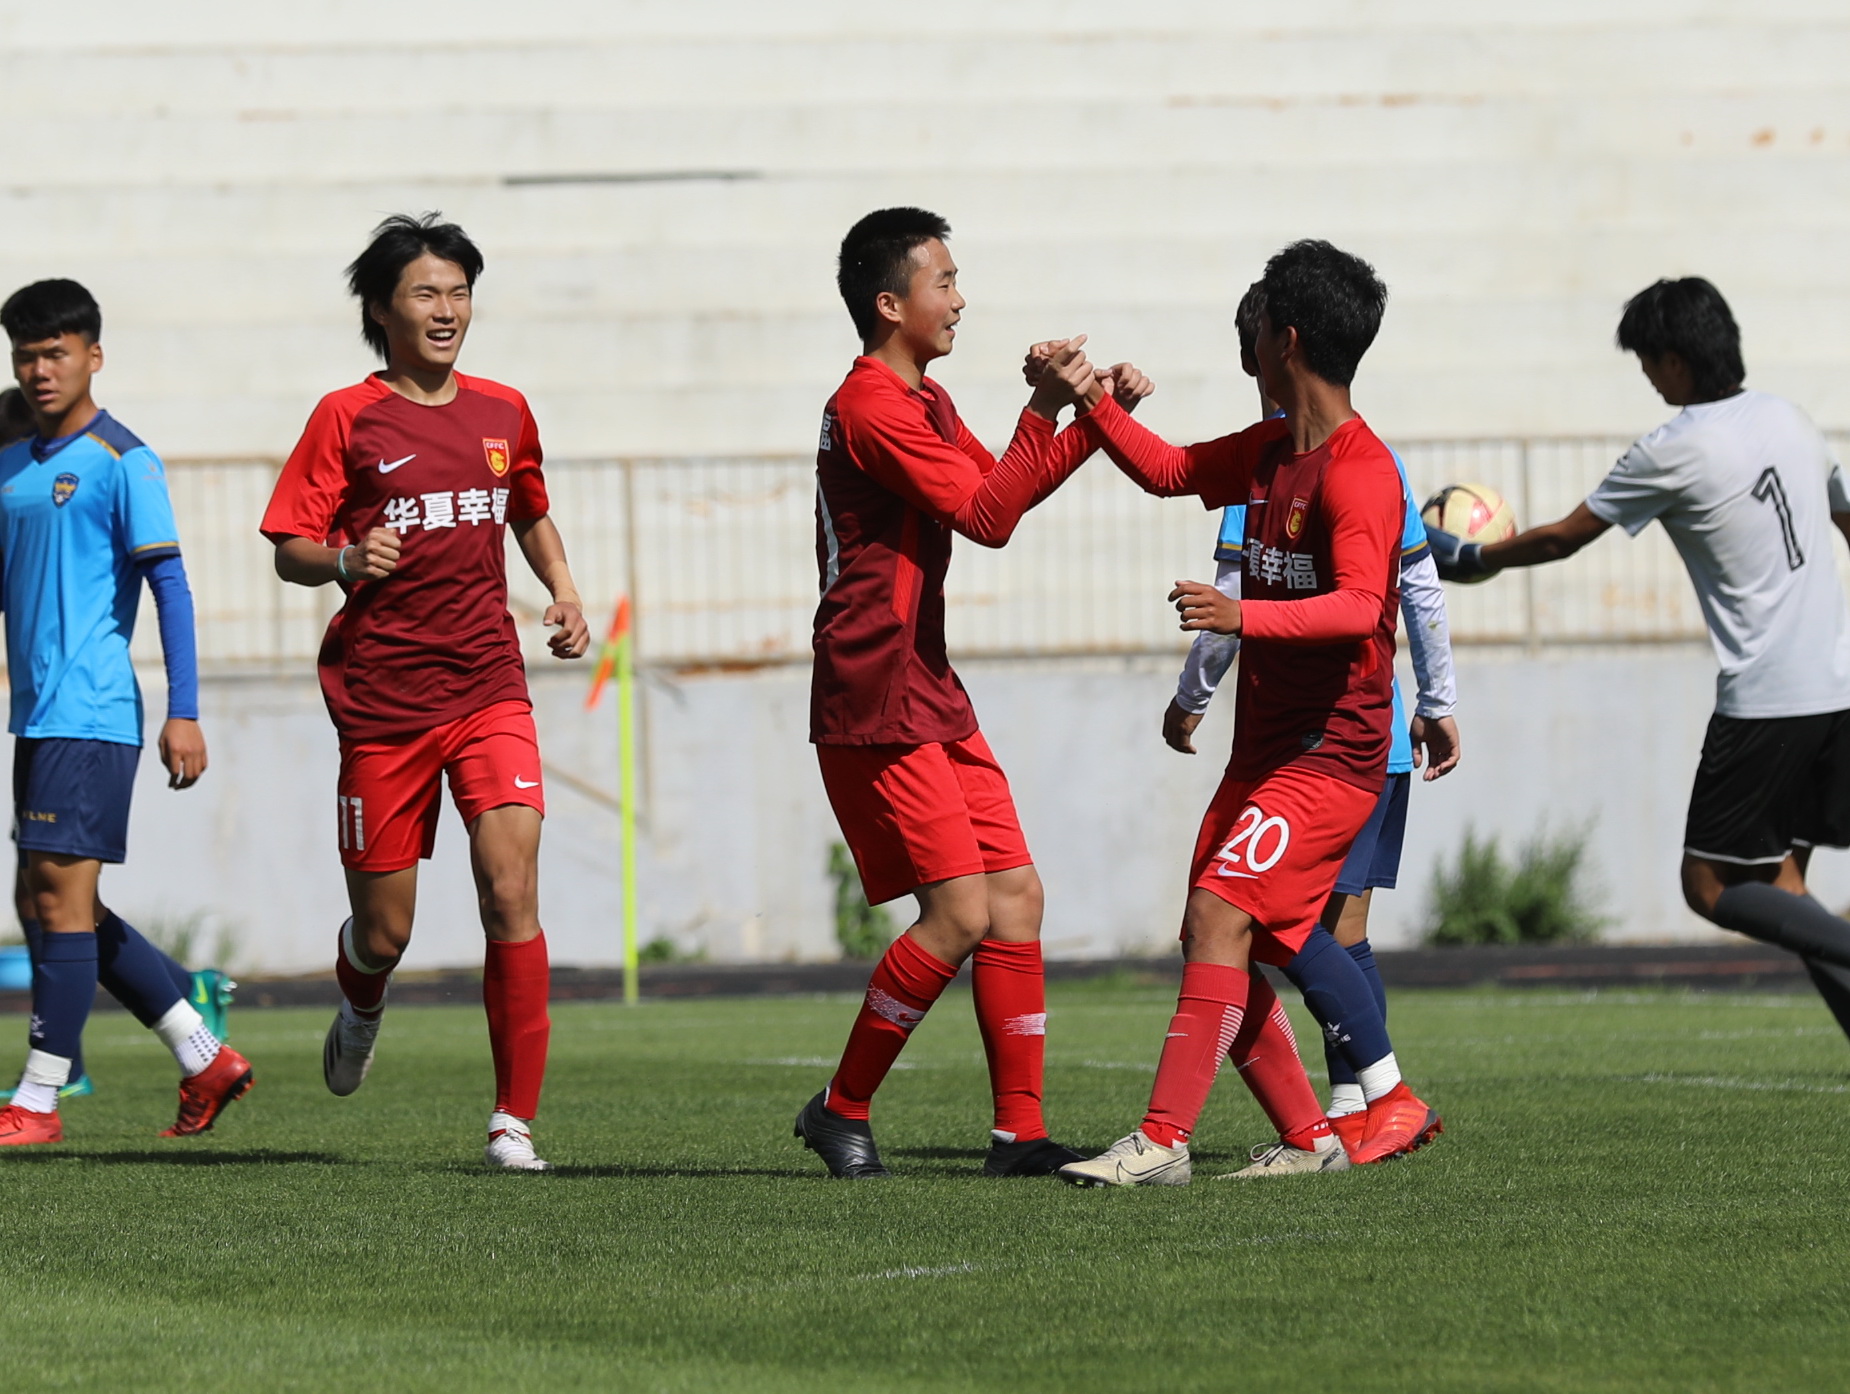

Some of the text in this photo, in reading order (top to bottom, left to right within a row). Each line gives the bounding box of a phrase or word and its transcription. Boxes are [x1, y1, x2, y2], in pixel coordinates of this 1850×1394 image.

[383, 487, 510, 535] 华夏幸福
[1751, 465, 1805, 572] 1
[1242, 538, 1317, 589] 夏幸福
[339, 795, 365, 851] 11
[1217, 806, 1290, 873] 20
